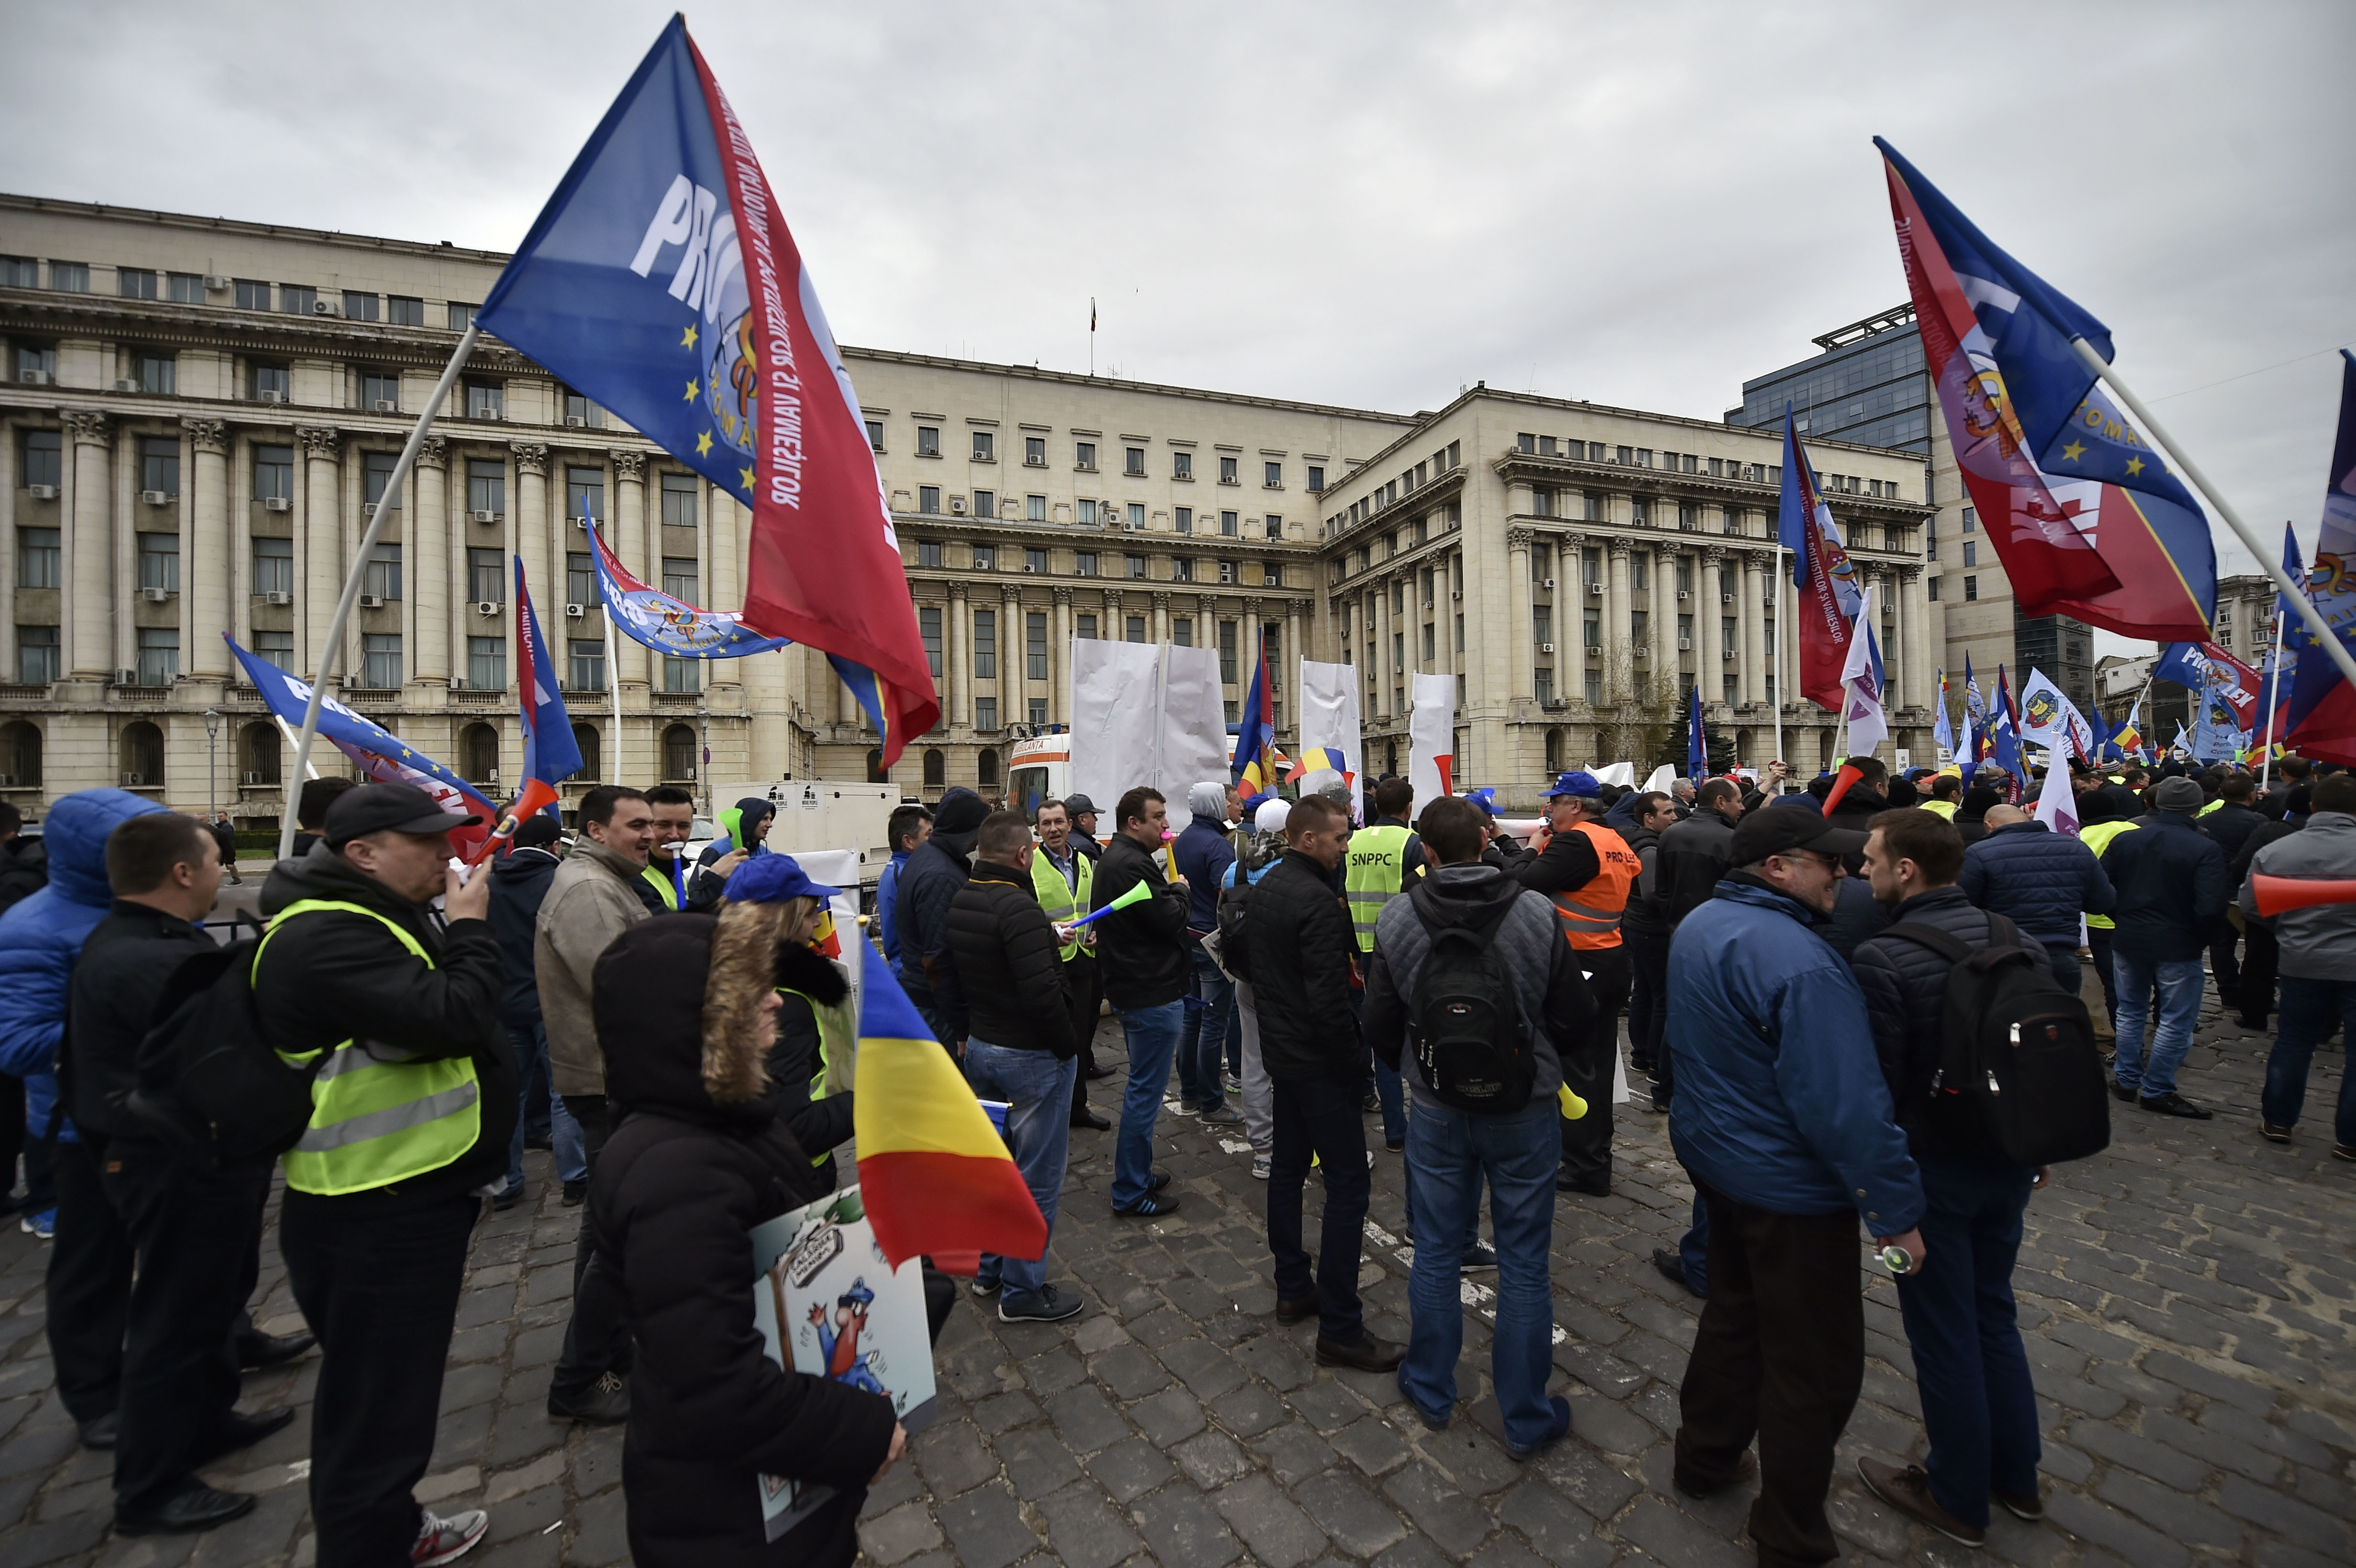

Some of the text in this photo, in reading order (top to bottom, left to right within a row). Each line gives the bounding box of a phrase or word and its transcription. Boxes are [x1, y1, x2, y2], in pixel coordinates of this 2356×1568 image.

[629, 173, 743, 325] PRO
[659, 632, 721, 650] ROMÂNIA
[2181, 646, 2211, 673] PRO
[2221, 684, 2256, 708] LEX
[1352, 853, 1392, 866] SNPPC
[1605, 851, 1624, 863] PRO
